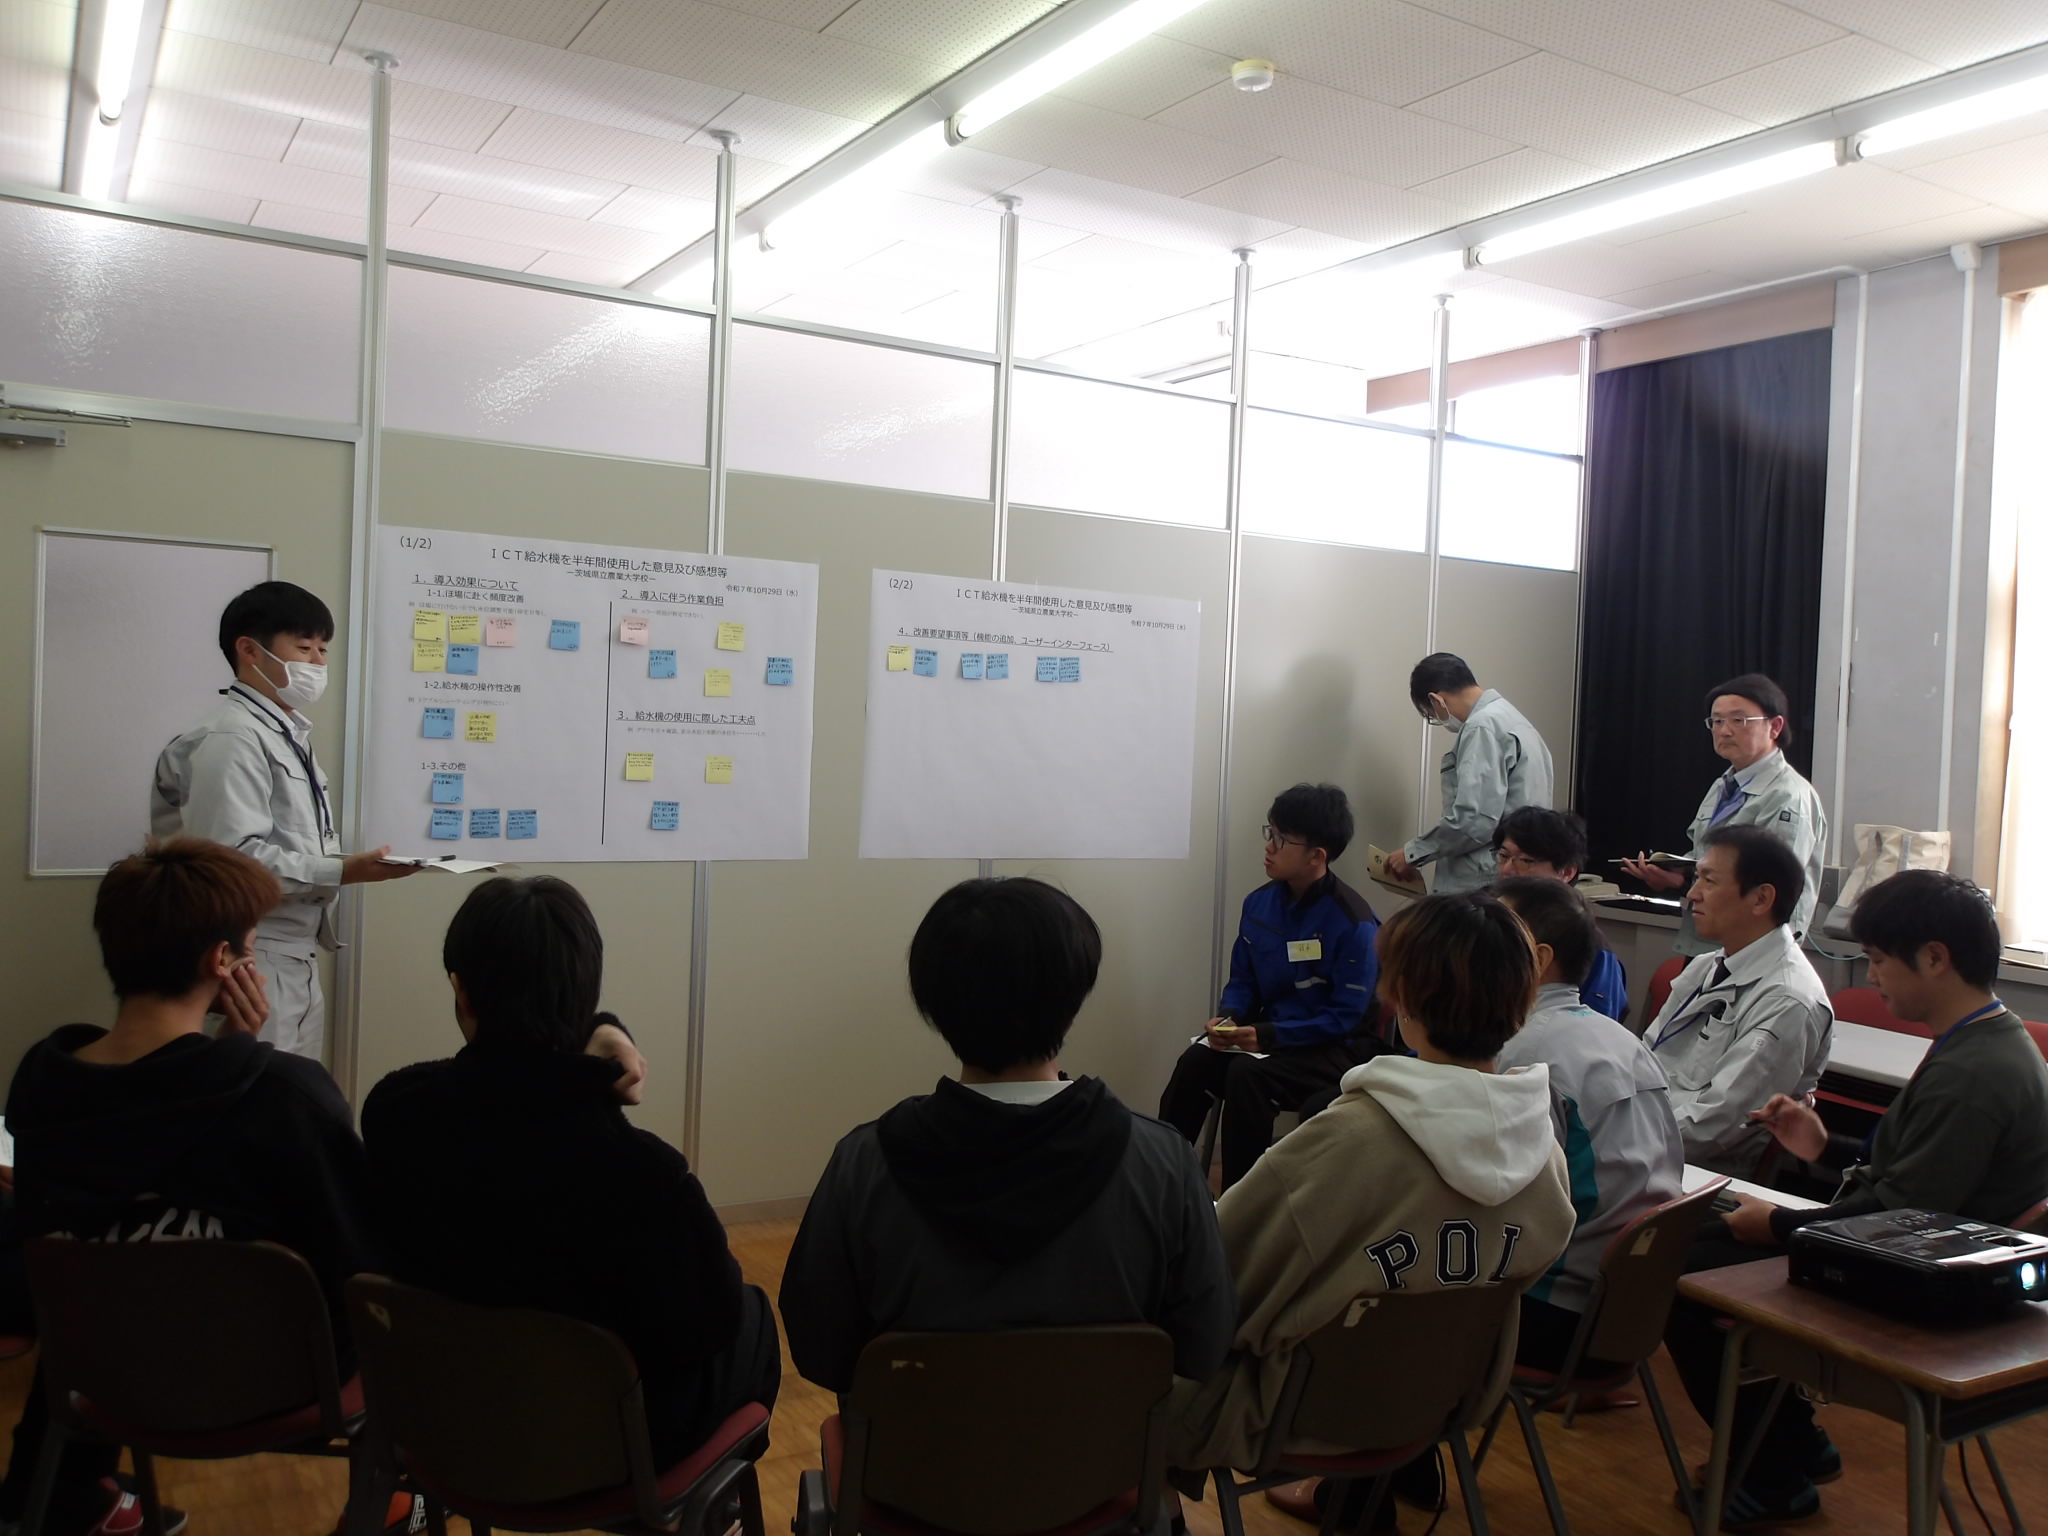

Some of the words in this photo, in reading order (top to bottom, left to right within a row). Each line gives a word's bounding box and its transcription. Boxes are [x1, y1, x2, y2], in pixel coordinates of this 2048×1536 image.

[400, 536, 432, 550] (1/2)
[889, 577, 913, 591] (2/2)
[421, 761, 467, 772] 1-3.その他
